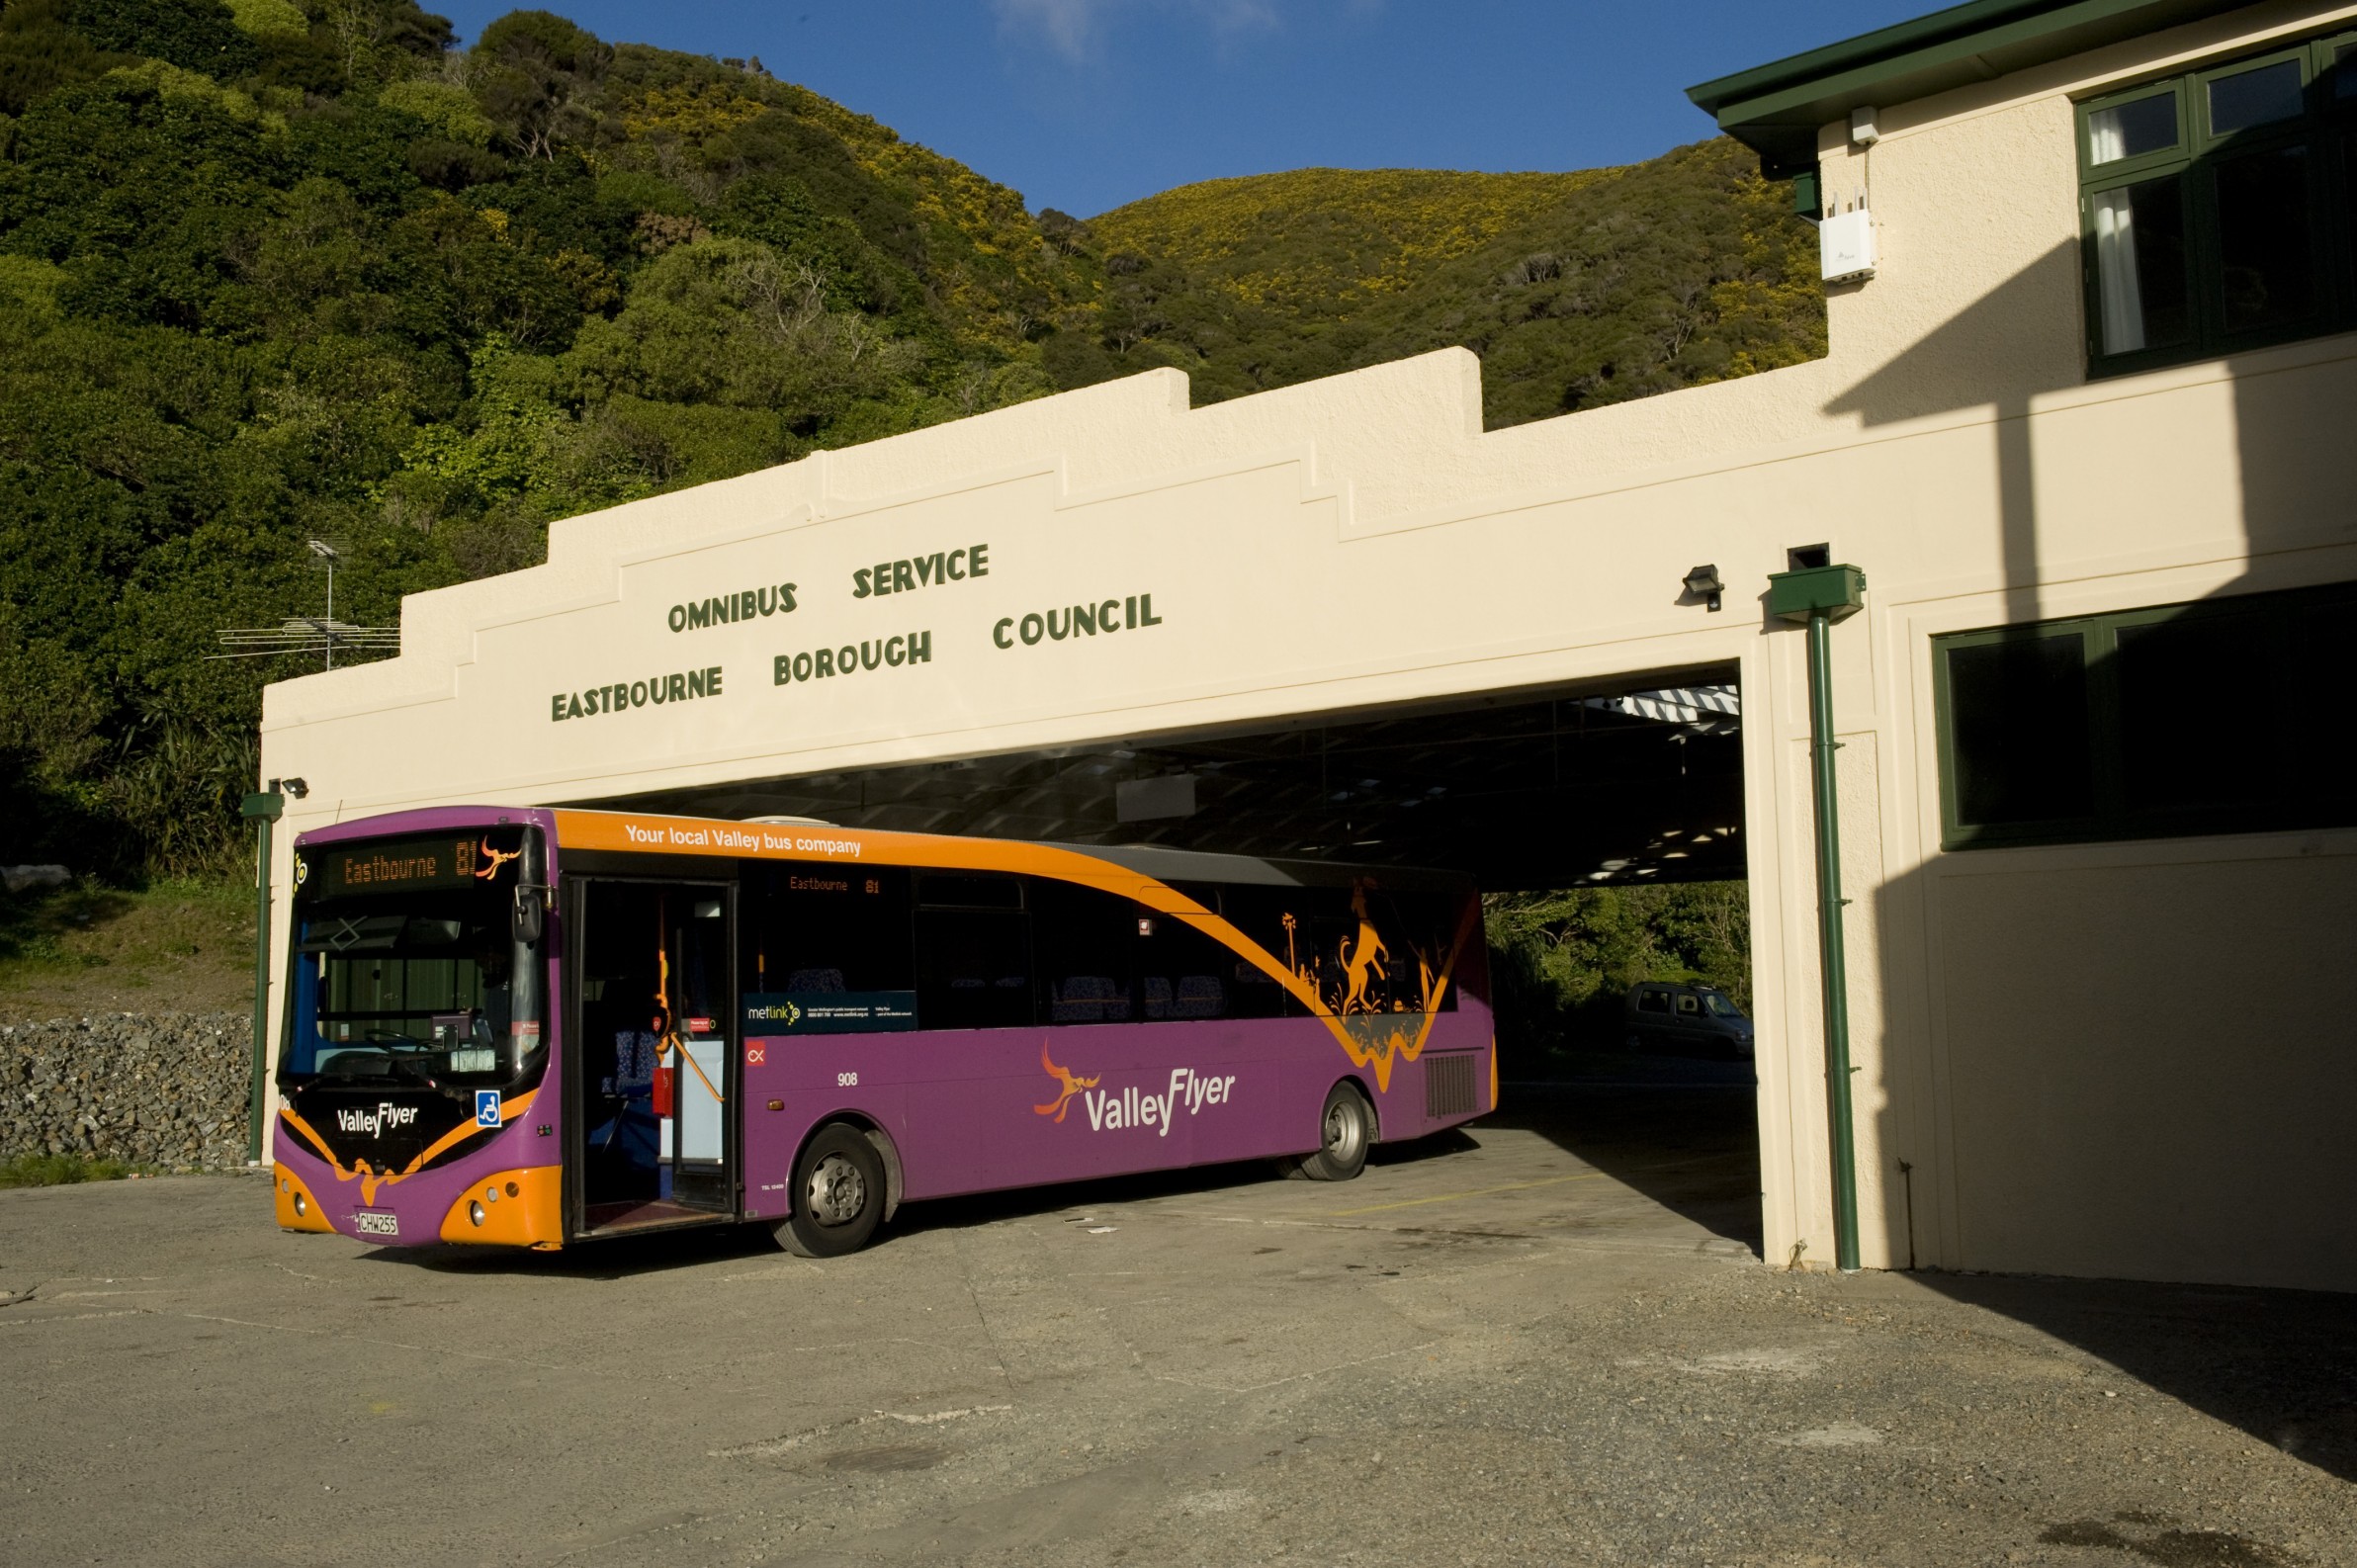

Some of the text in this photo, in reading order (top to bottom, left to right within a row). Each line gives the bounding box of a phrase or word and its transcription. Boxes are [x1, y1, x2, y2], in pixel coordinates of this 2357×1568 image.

[668, 543, 989, 633] OMNIBUS SERVICE
[552, 593, 1163, 723] EASTBOURNE BOROUGH COUNCIL
[625, 825, 861, 857] Your local Valley bus company
[345, 855, 436, 884] Eastbourne
[791, 876, 879, 894] Eastbourne 81
[748, 1005, 788, 1019] metlink
[837, 1072, 858, 1087] 908
[360, 1215, 396, 1233] CHW255
